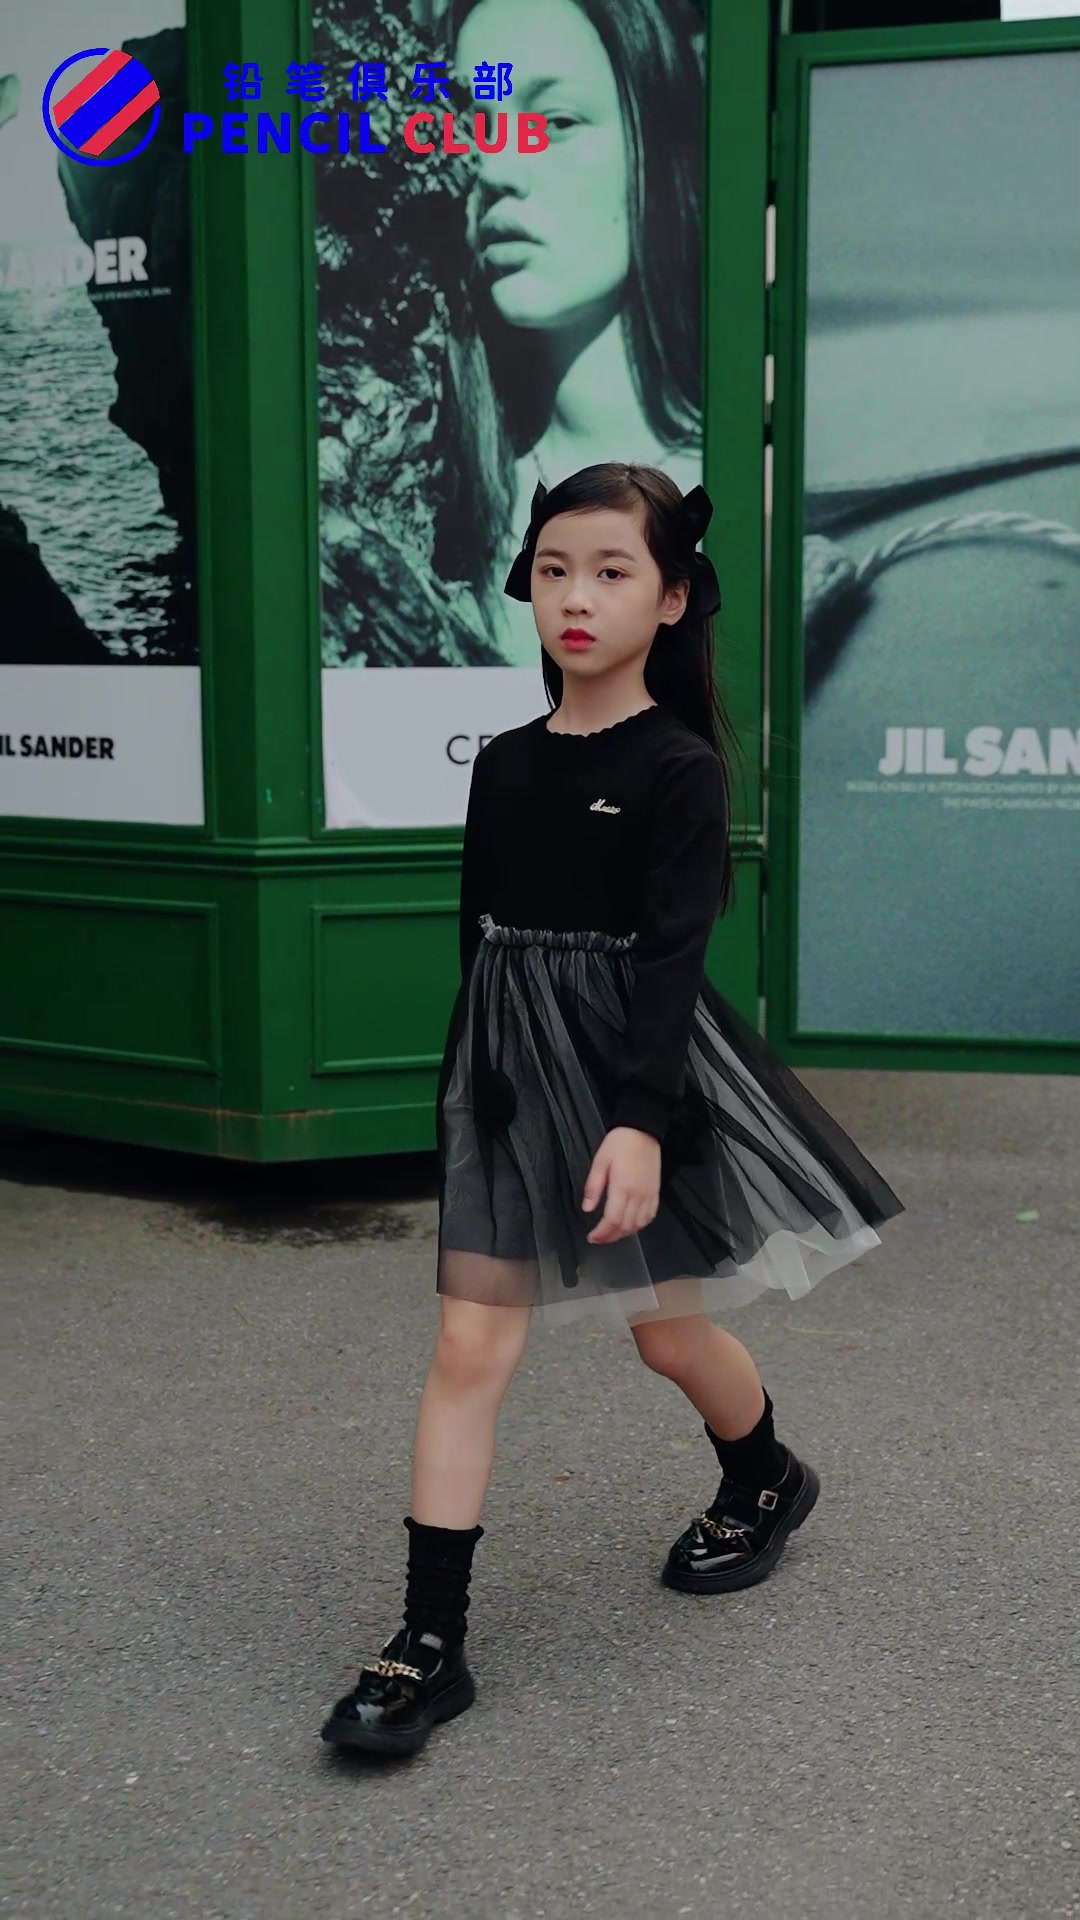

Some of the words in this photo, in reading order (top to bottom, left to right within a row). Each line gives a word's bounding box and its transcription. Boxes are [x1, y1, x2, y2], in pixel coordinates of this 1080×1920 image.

[0, 236, 149, 288] ANDER
[20, 735, 115, 760] SANDER
[878, 727, 958, 776] JIL
